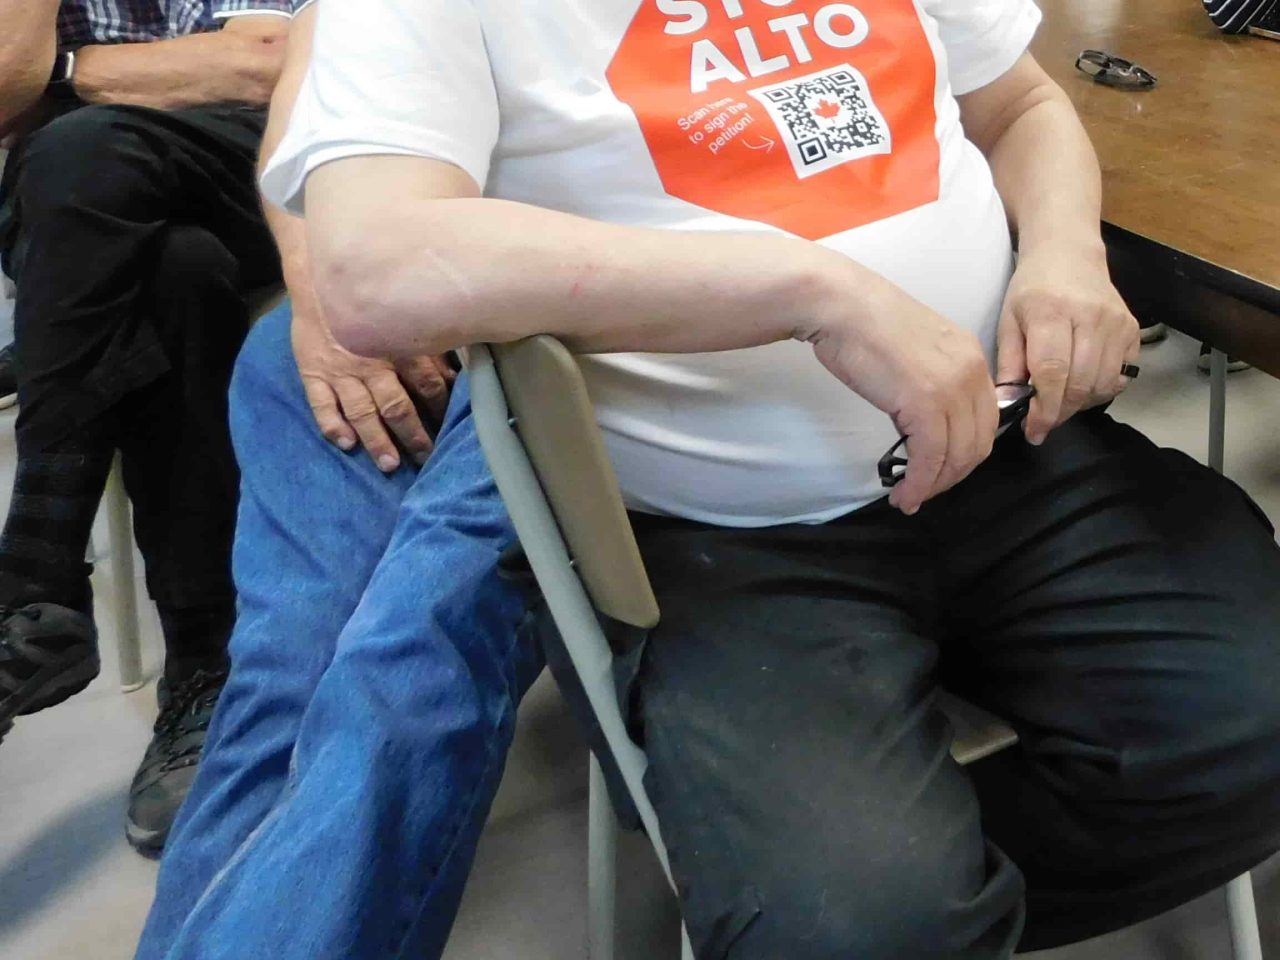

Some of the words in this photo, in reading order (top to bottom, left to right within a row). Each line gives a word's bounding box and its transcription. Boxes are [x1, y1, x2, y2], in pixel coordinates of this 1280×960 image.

[690, 3, 869, 93] ALTO
[677, 107, 710, 130] Scan
[689, 131, 704, 145] to
[704, 112, 730, 133] sign
[726, 102, 748, 115] the
[708, 112, 755, 155] petition!
